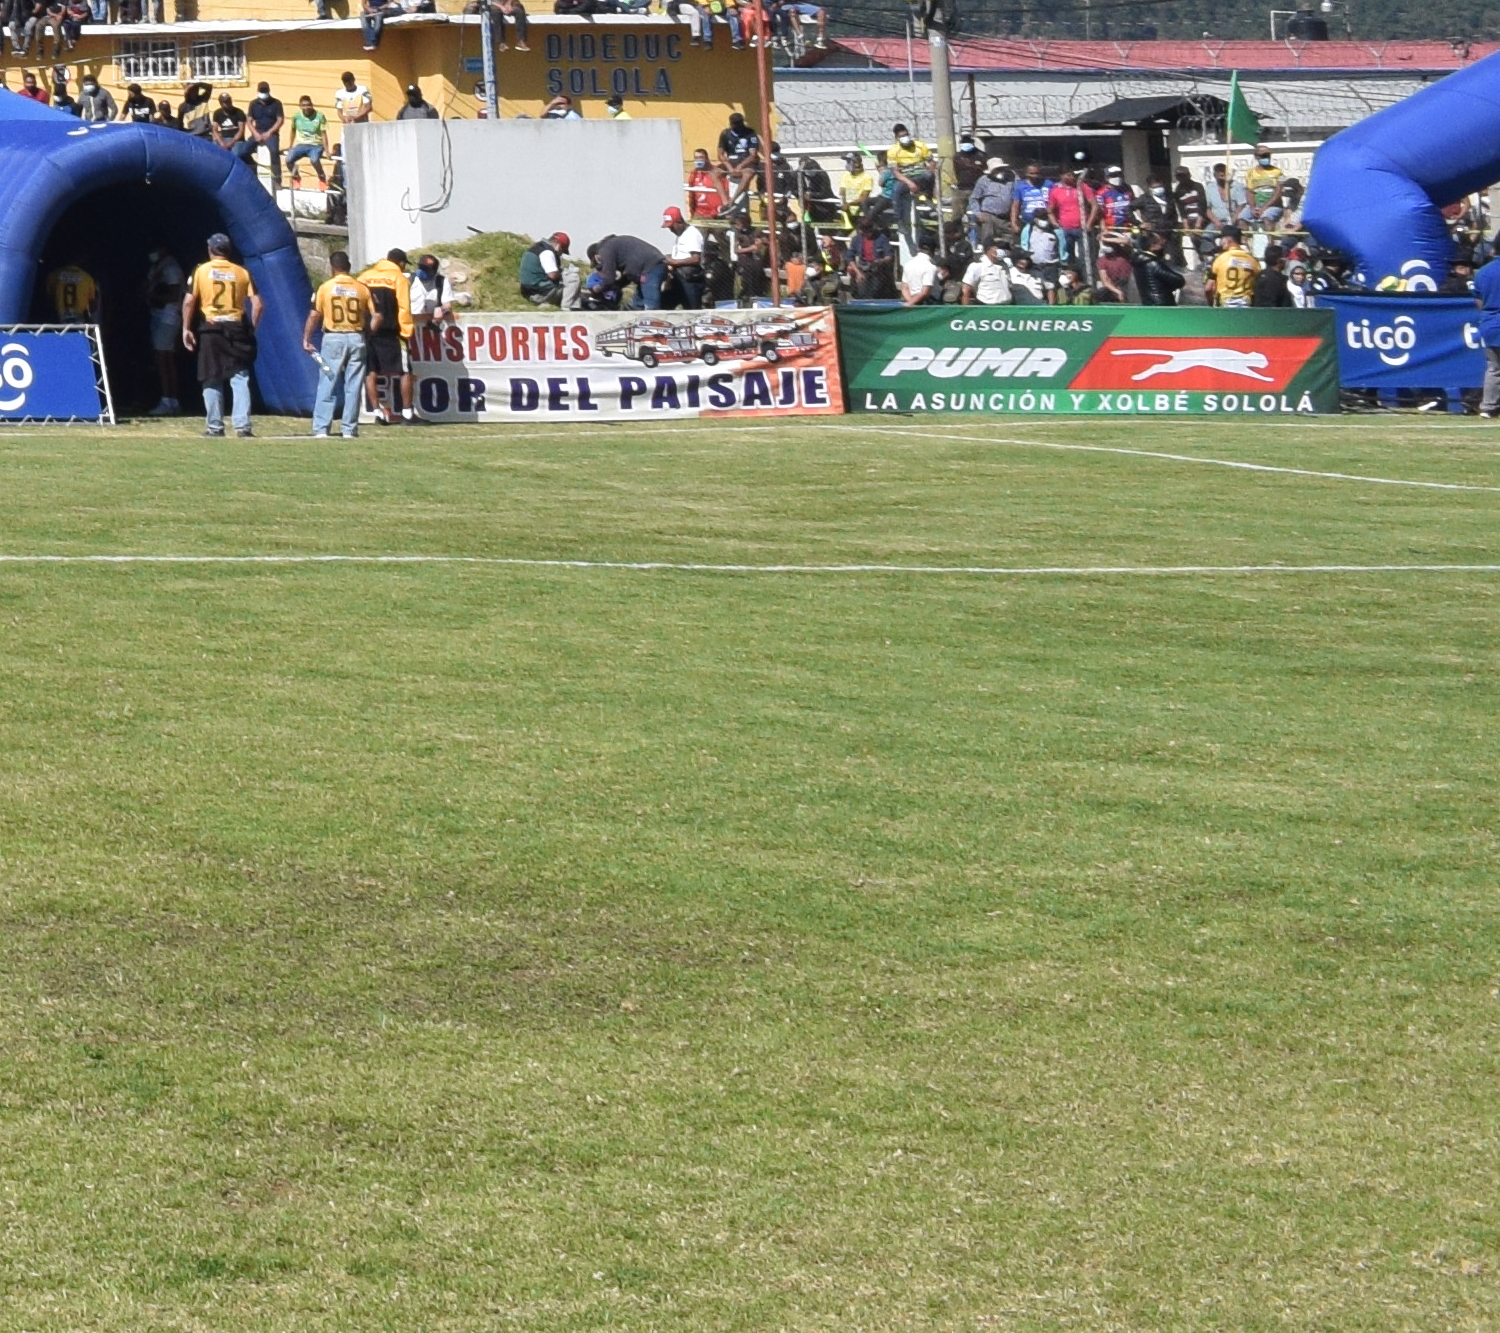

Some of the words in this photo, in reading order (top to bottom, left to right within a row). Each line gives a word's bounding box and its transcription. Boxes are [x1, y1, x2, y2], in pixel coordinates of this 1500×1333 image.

[546, 33, 682, 62] DIDEDUC
[546, 67, 673, 96] SOLOLA
[212, 282, 237, 309] 21
[331, 297, 361, 324] 69
[950, 319, 1093, 333] GASOLINERAS
[1347, 316, 1417, 350] tigo
[880, 347, 1067, 378] PUMA
[510, 378, 597, 411] DEL
[618, 368, 829, 411] PAISAJE
[865, 393, 898, 410] LA
[910, 389, 1054, 412] ASUNCIÓN
[1070, 394, 1085, 411] Y
[1100, 390, 1189, 412] XOLBÉ
[1203, 390, 1314, 412] SOLOLÁ
